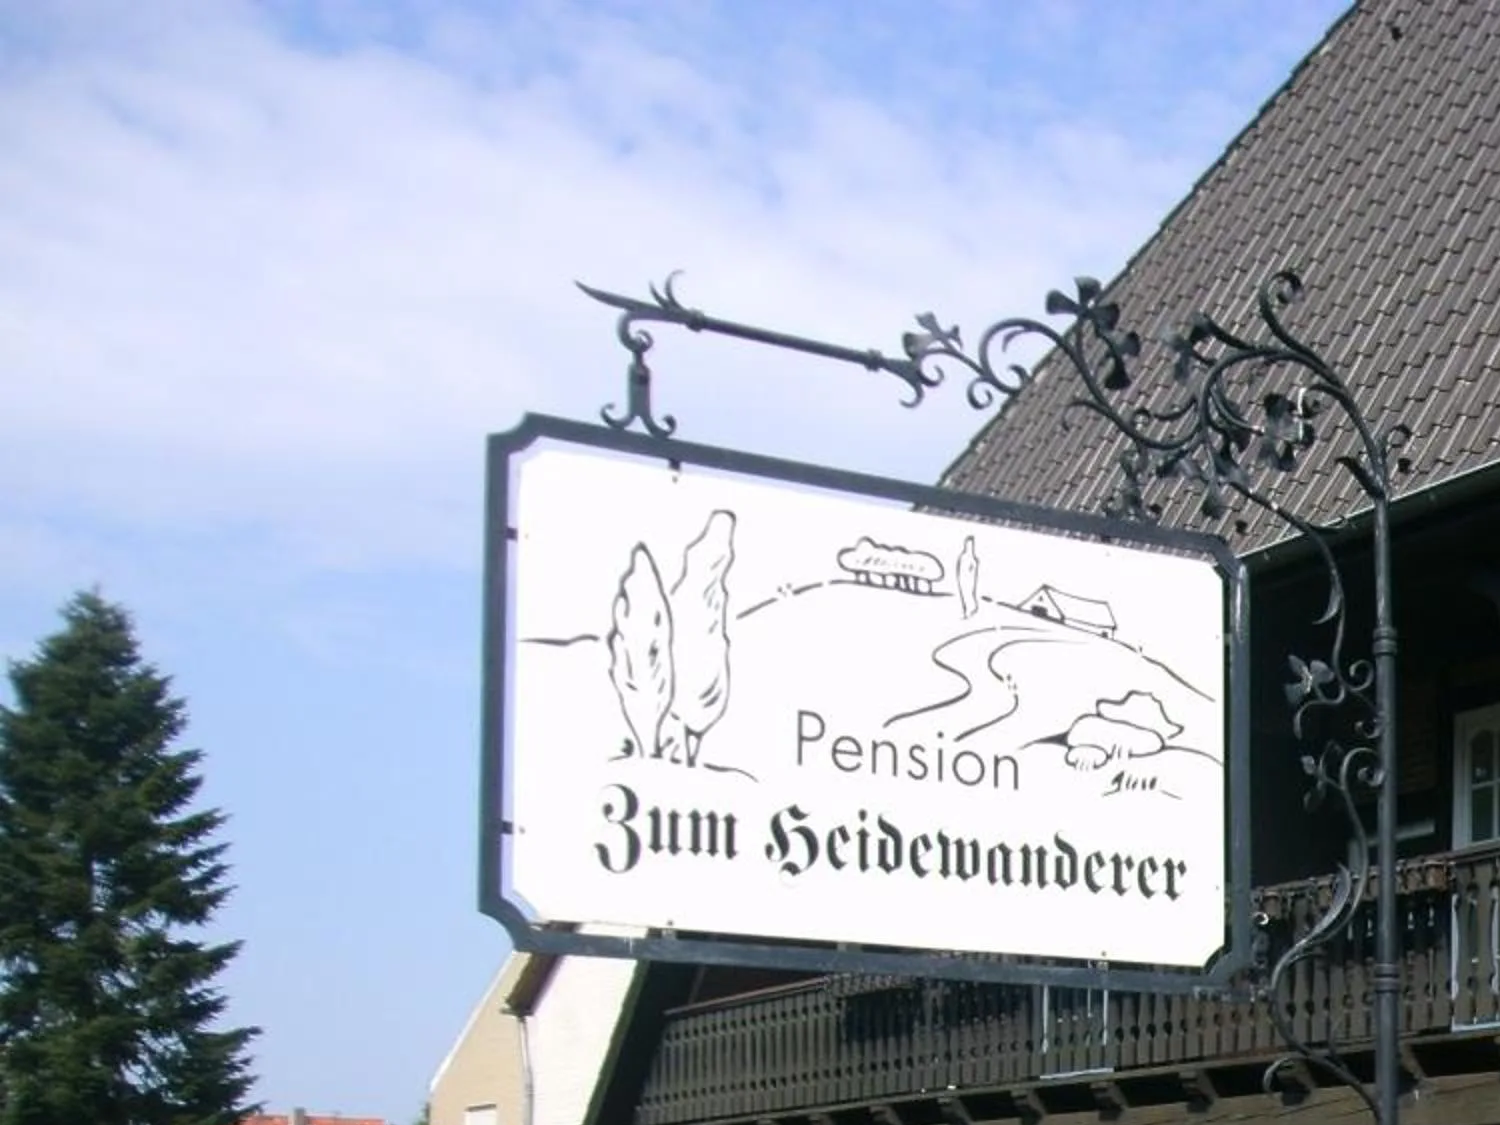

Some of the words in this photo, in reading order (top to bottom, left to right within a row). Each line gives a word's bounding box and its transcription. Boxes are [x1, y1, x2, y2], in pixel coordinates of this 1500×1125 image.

[795, 709, 1020, 791] Pension
[594, 784, 739, 876] Zum
[763, 804, 1189, 902] Heidewanderer
